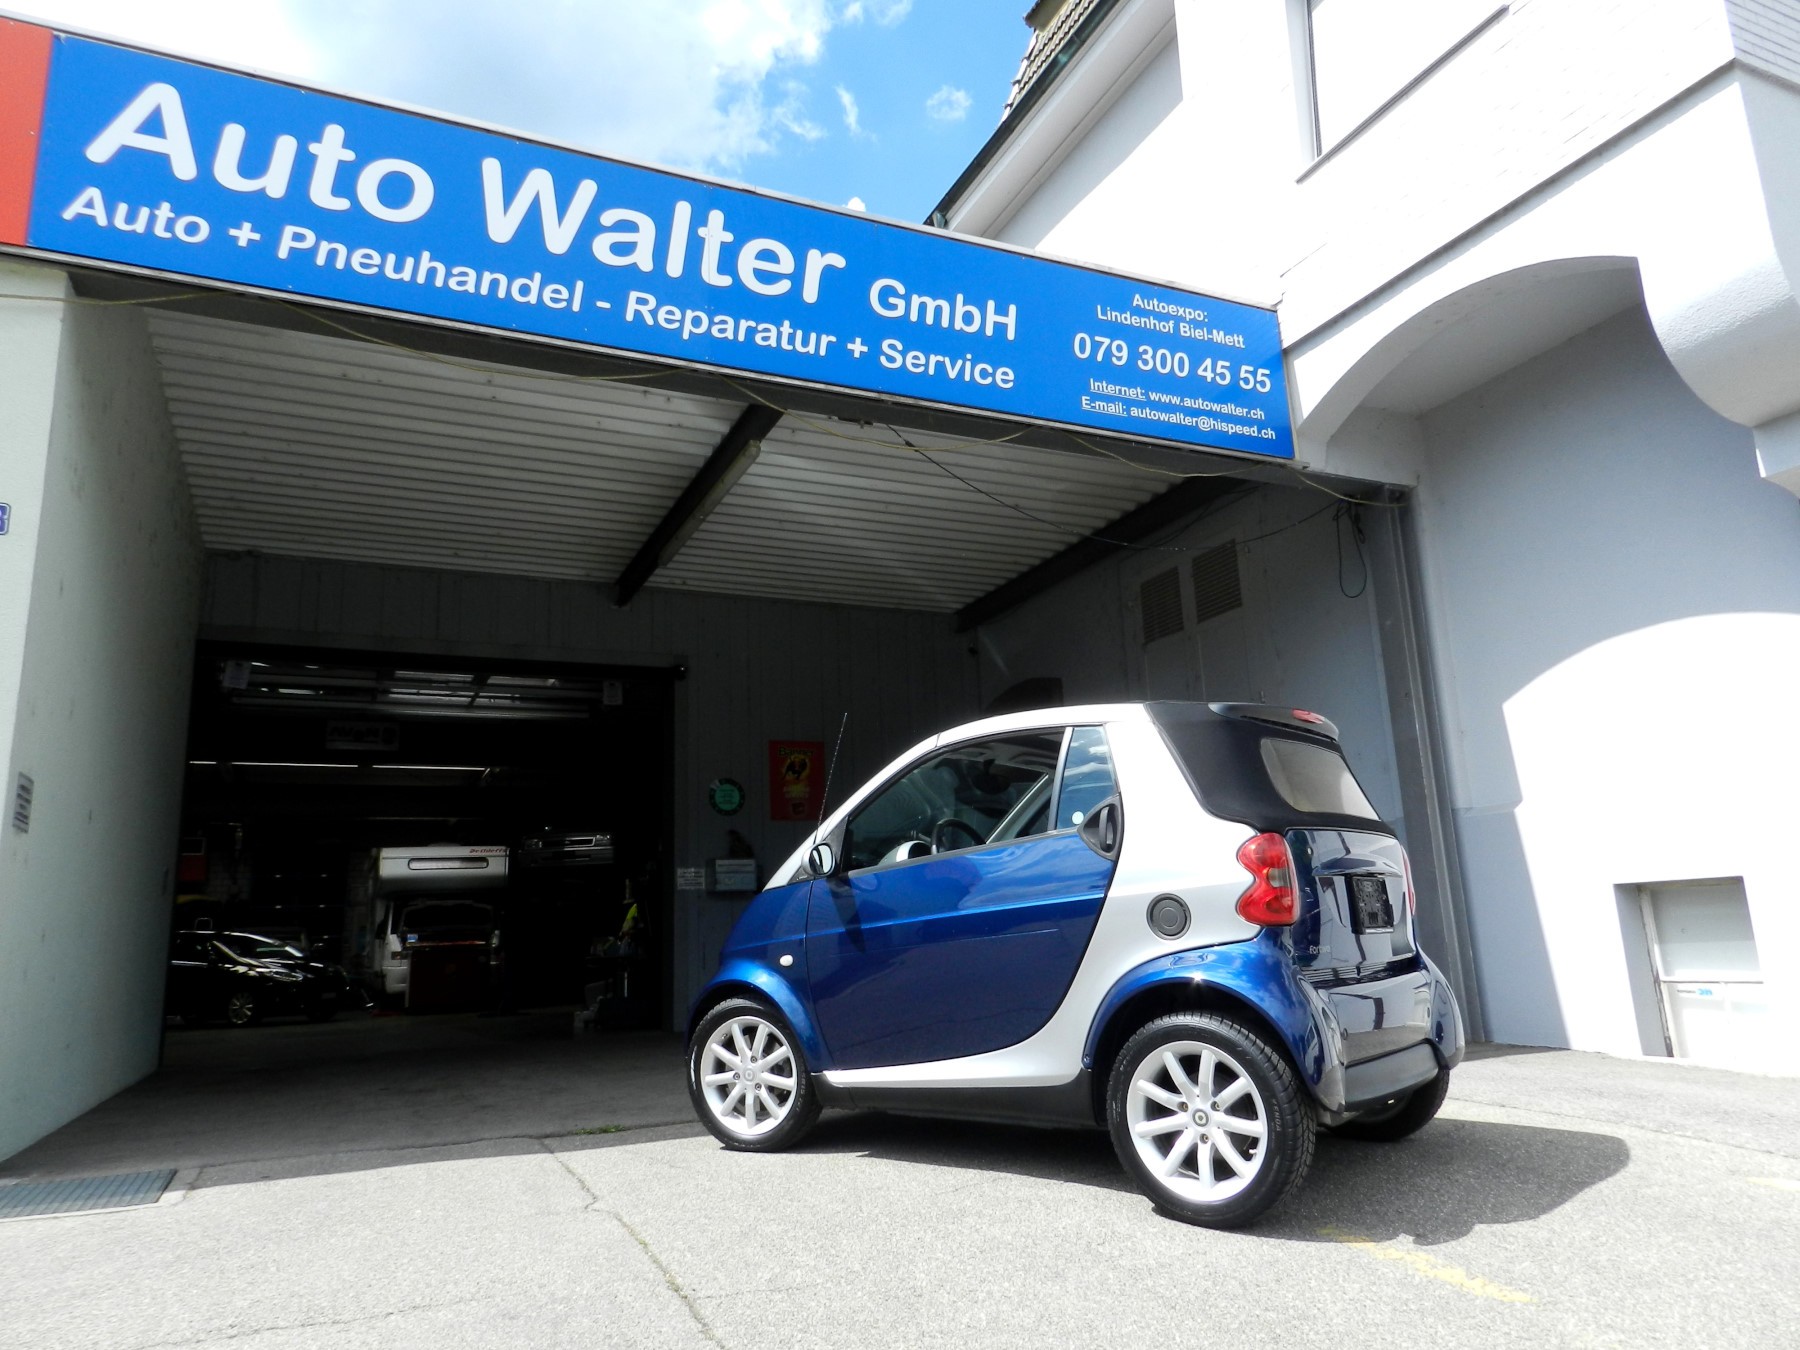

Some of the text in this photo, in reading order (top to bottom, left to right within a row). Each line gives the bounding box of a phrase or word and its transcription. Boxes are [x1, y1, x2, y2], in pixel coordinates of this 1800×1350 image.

[84, 81, 1017, 341] Auto Walter GmbH
[61, 186, 211, 244] Auto
[277, 224, 584, 314] Pneuhandel
[625, 290, 836, 357] Reparatur
[879, 338, 1015, 390] Service
[1132, 293, 1209, 323] Autoexpo:
[1097, 304, 1246, 350] Lindenhof Biel-Mett
[1073, 332, 1272, 393] 079 300 45 55
[1081, 395, 1276, 441] E-mail: autowalter@hispeed.ch
[1089, 378, 1265, 421] Internet: www.autowalter.ch
